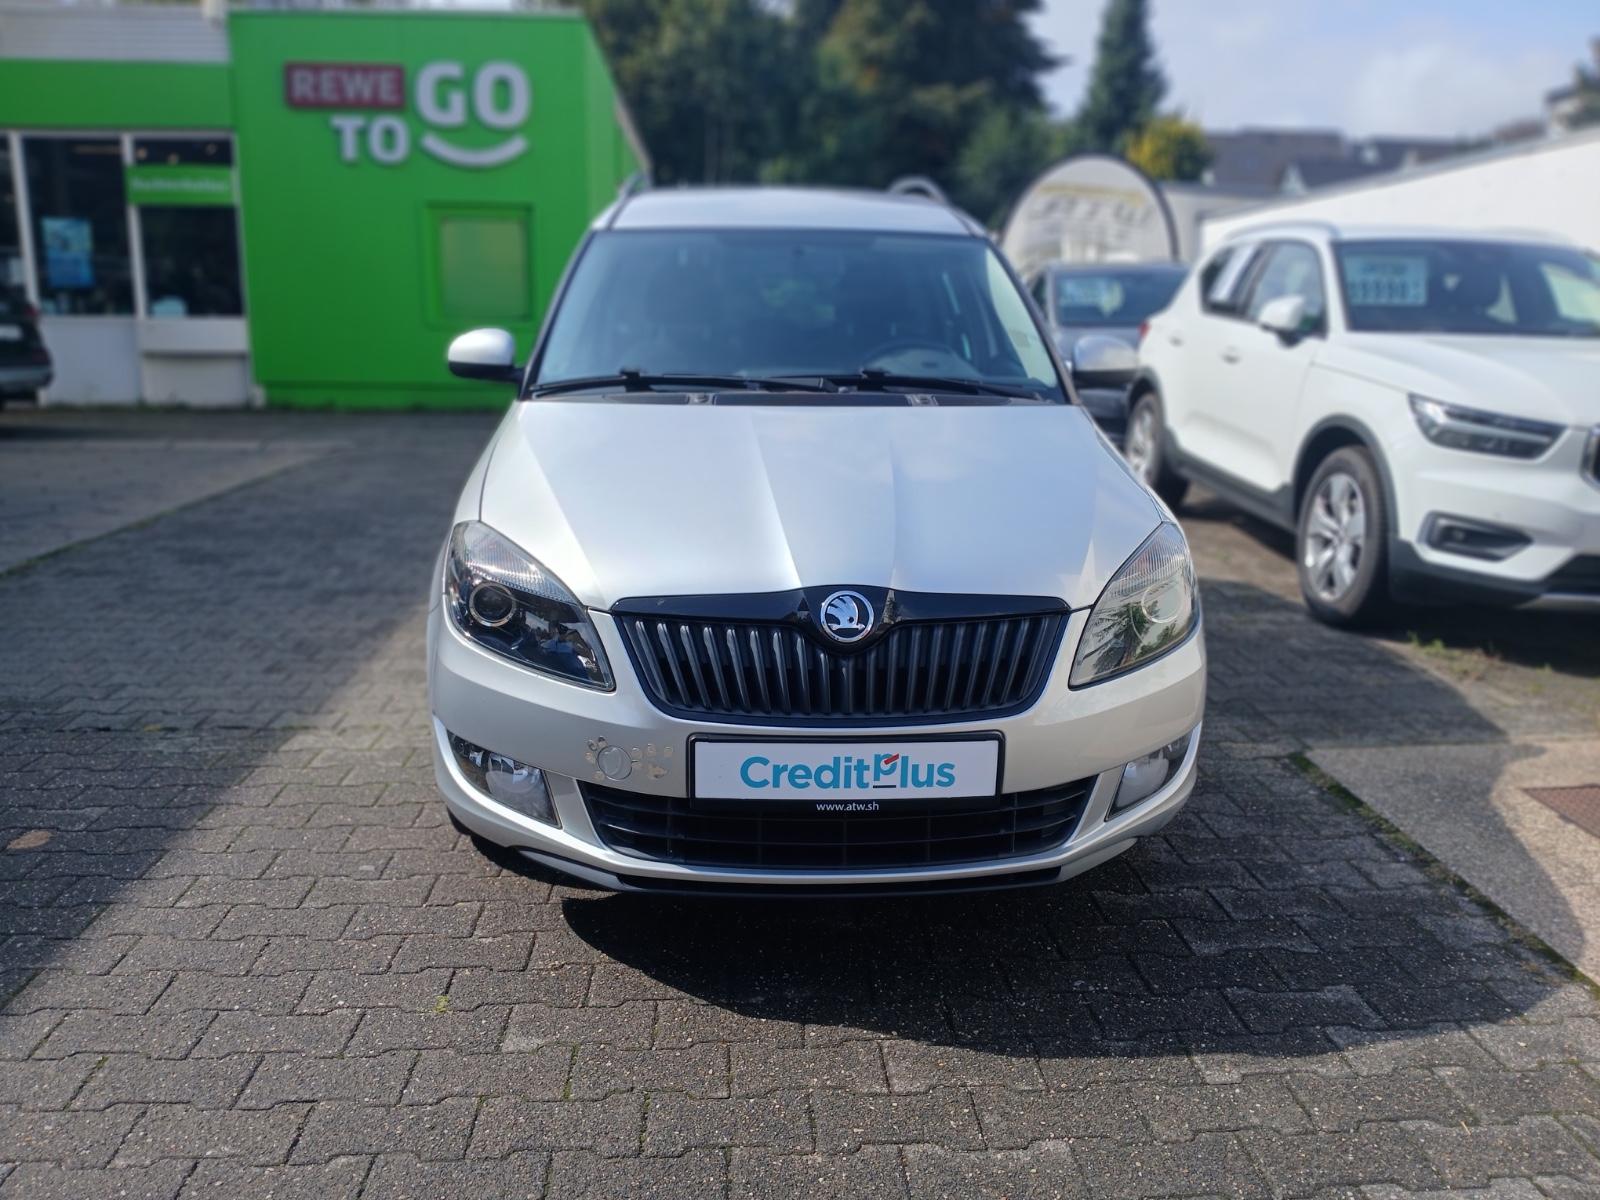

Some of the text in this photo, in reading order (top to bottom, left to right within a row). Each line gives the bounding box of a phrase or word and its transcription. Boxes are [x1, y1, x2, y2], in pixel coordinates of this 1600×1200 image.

[291, 68, 398, 102] REWE
[331, 61, 532, 165] TO GO
[815, 800, 880, 812] www.atw.sh
